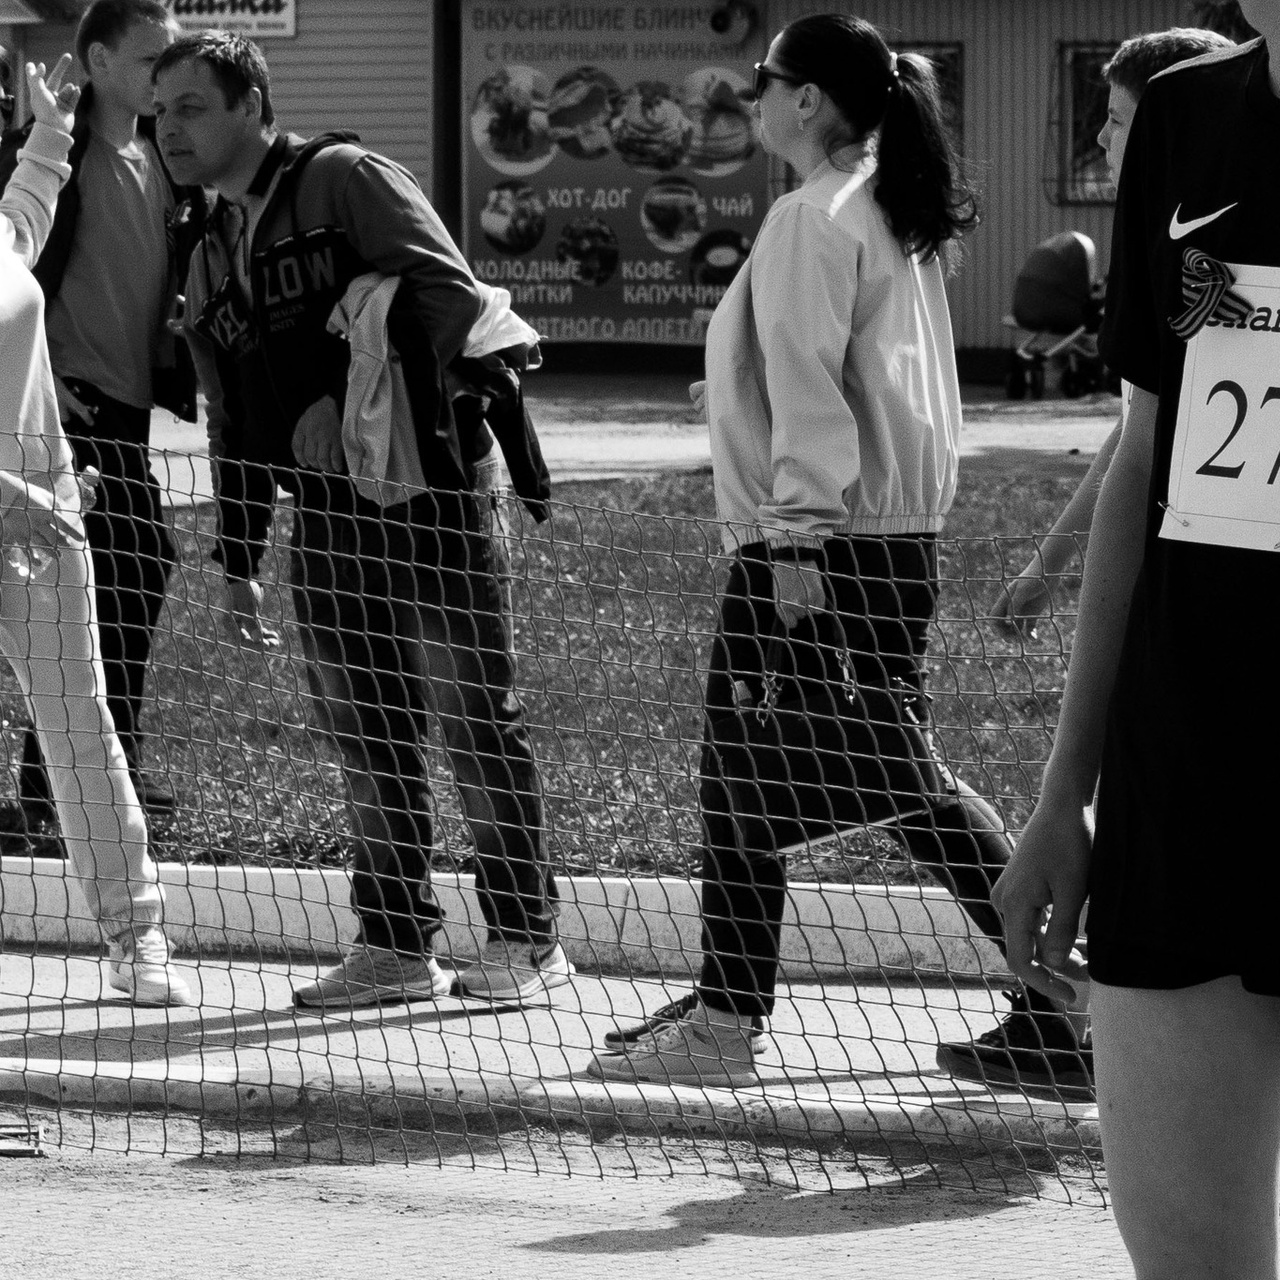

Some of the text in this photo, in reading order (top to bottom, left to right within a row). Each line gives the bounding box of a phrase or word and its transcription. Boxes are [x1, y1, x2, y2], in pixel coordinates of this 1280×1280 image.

[472, 4, 625, 31] ВКУСНЕЙШИЕ
[502, 42, 626, 61] РАЗЛИЧНЫМИ
[547, 188, 631, 211] ХОТ-ДОГ
[713, 194, 753, 215] ЧАЙ
[263, 247, 336, 306] LOW
[474, 259, 582, 281] ХОЛОДНЫЕ
[511, 285, 573, 304] ПИТКИ
[623, 285, 726, 305] КАПУЧЧИН
[530, 317, 615, 339] ЯТНОГО
